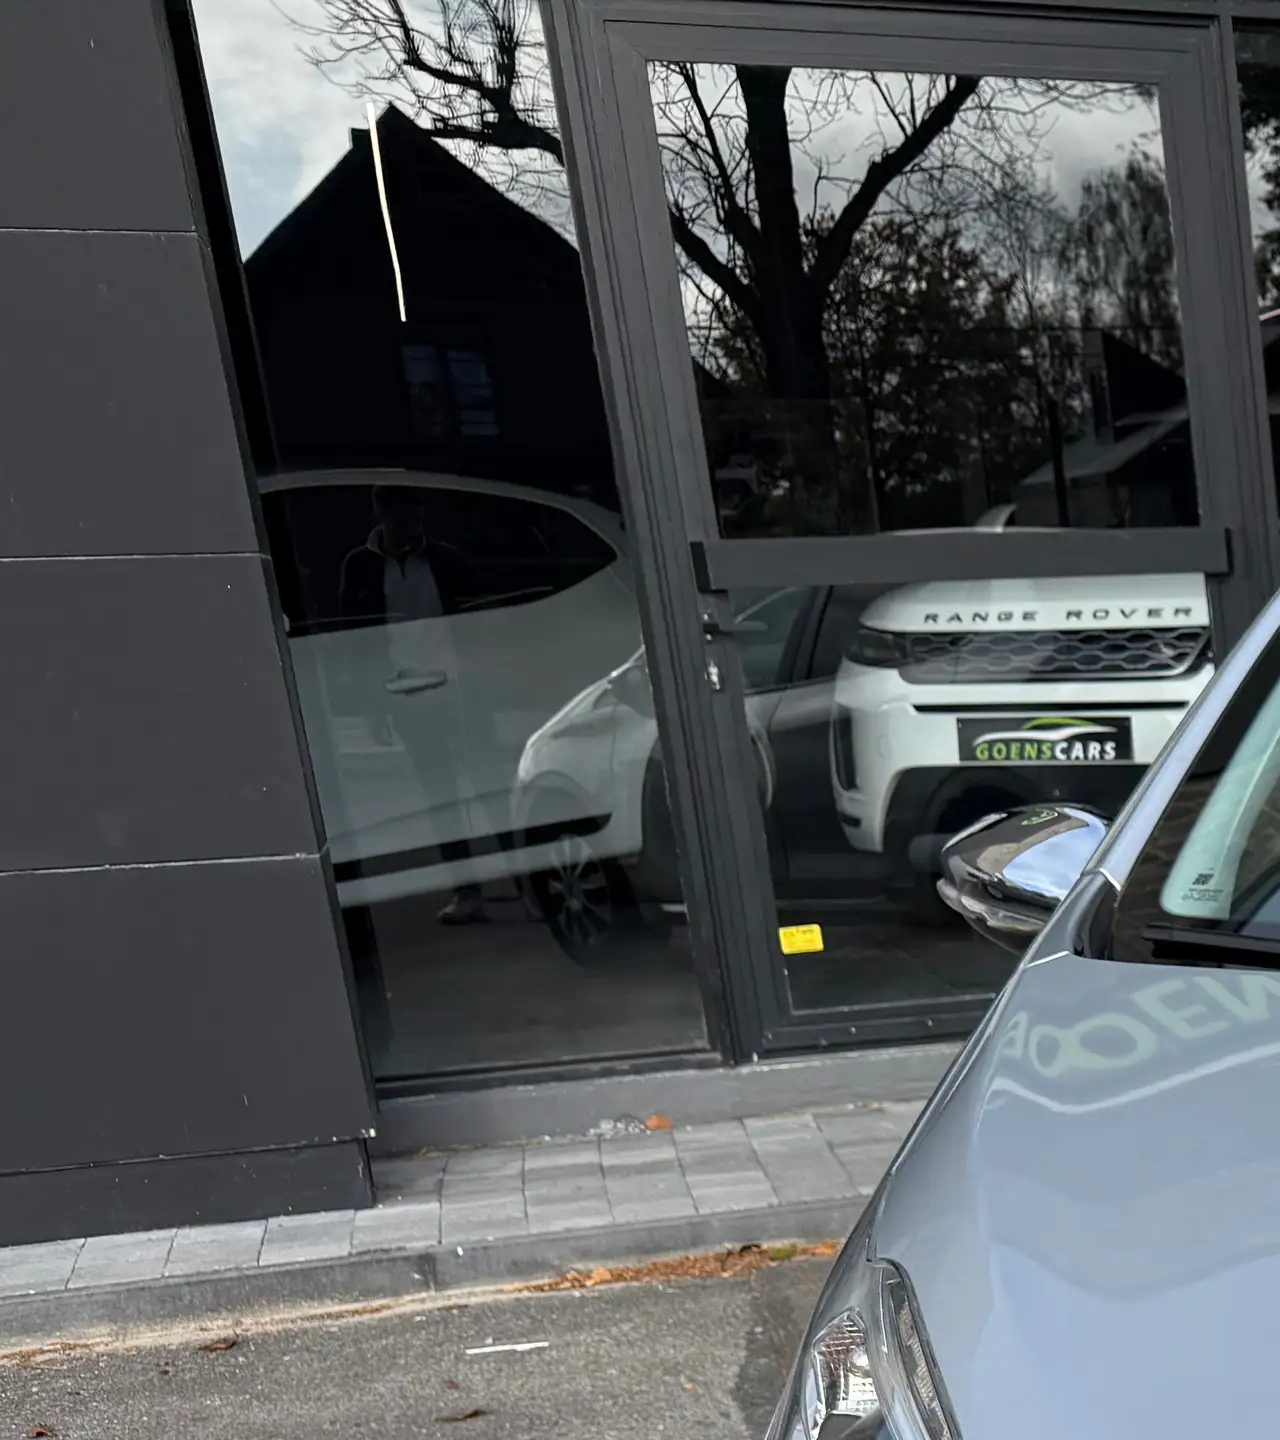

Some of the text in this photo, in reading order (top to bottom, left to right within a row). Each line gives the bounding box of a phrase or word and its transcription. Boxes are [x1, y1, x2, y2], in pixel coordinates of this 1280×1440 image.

[923, 607, 1193, 624] RANGE ROVER
[975, 741, 1117, 761] GOENSCARS
